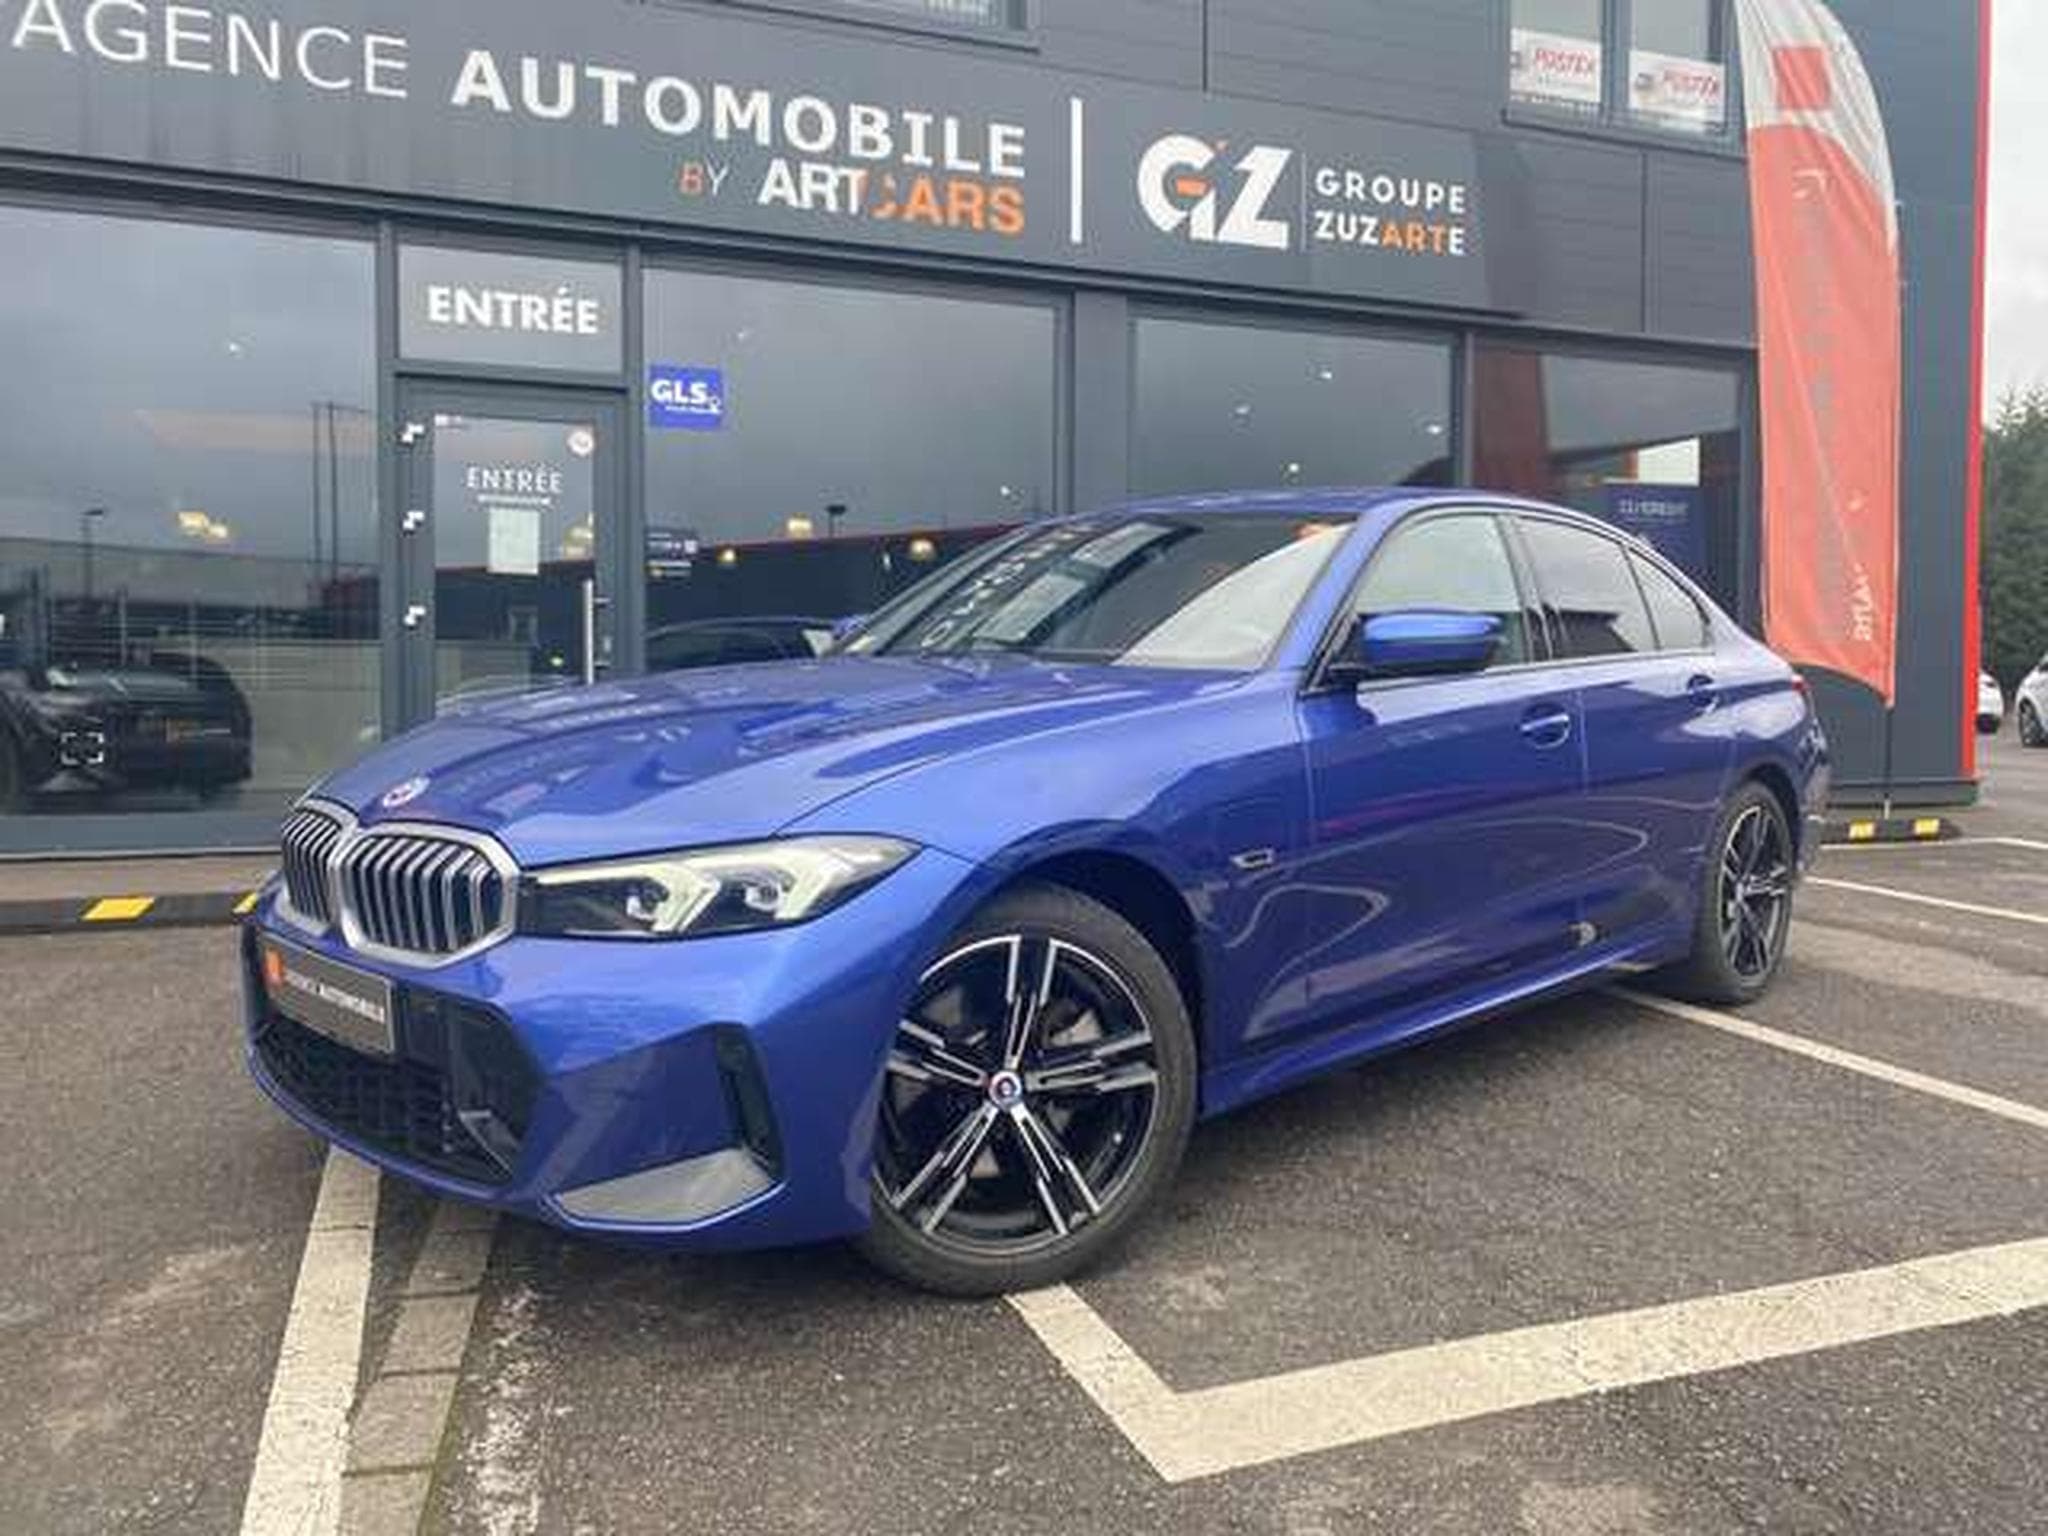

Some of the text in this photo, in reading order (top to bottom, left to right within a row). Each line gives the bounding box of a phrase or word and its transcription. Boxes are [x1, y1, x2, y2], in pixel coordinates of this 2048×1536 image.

[12, 0, 1026, 179] AGENCE AUTOMOBILE
[679, 160, 728, 198] BY
[1314, 166, 1467, 215] GROUPE
[1312, 209, 1467, 257] ZUZARTE
[428, 283, 600, 336] ENTRÉE
[651, 378, 708, 405] GLS
[466, 463, 562, 494] ENTRÉE
